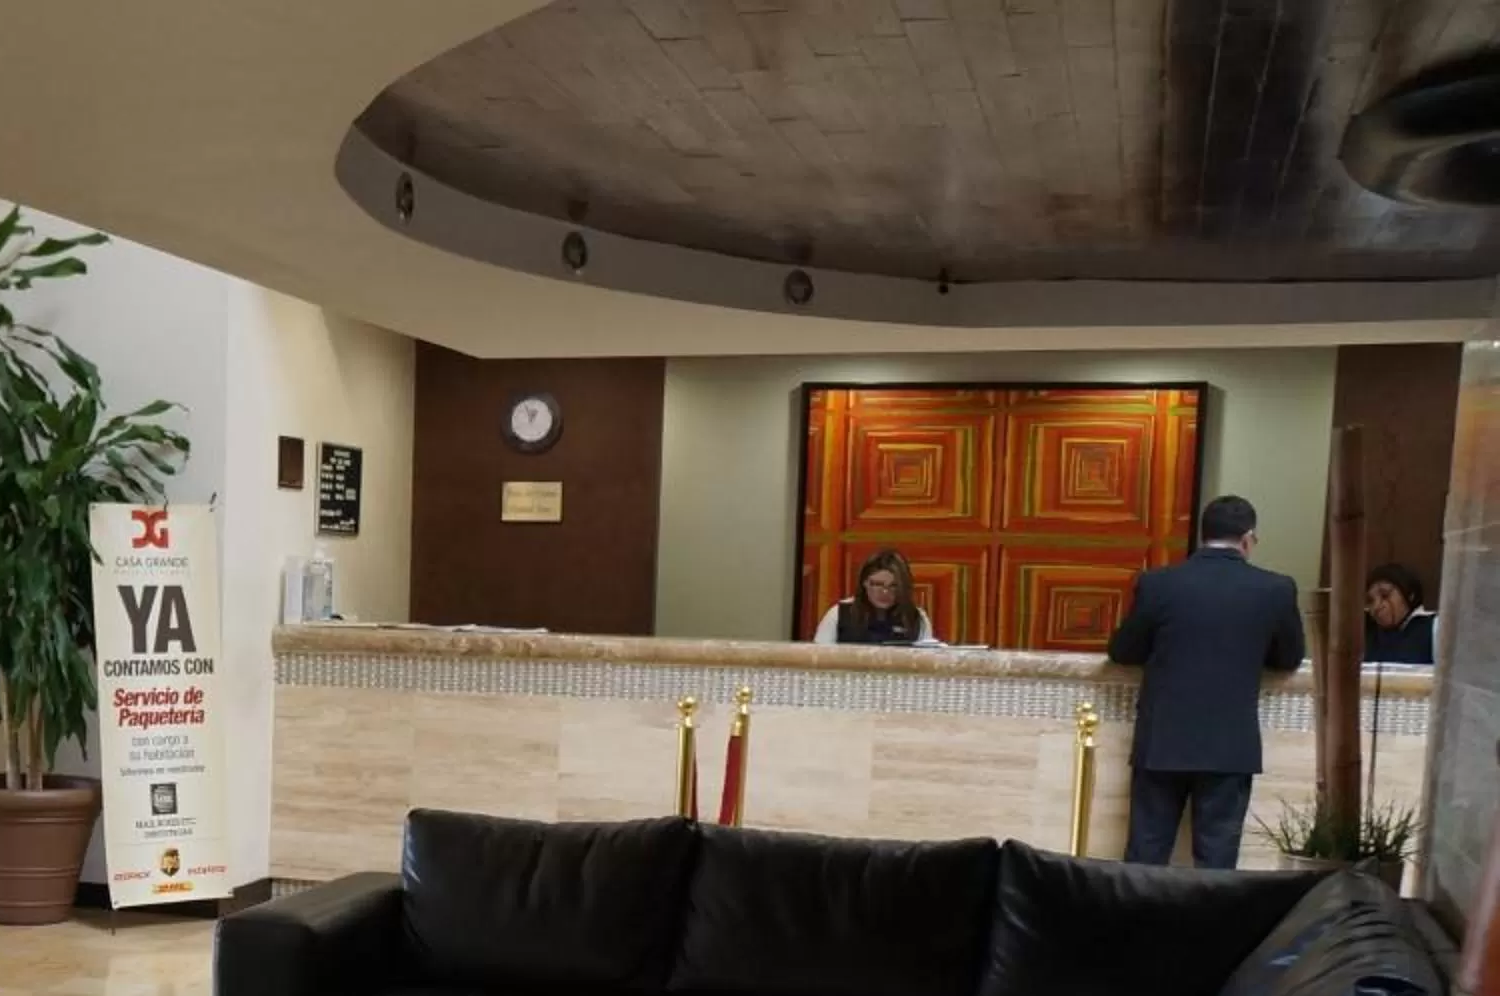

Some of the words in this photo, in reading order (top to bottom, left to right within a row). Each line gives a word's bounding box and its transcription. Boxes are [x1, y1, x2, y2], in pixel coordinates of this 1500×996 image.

[117, 585, 197, 654] YA
[104, 660, 181, 677] CONTAMOS
[184, 658, 214, 675] CON
[114, 688, 179, 708] Servicio
[183, 685, 204, 705] de
